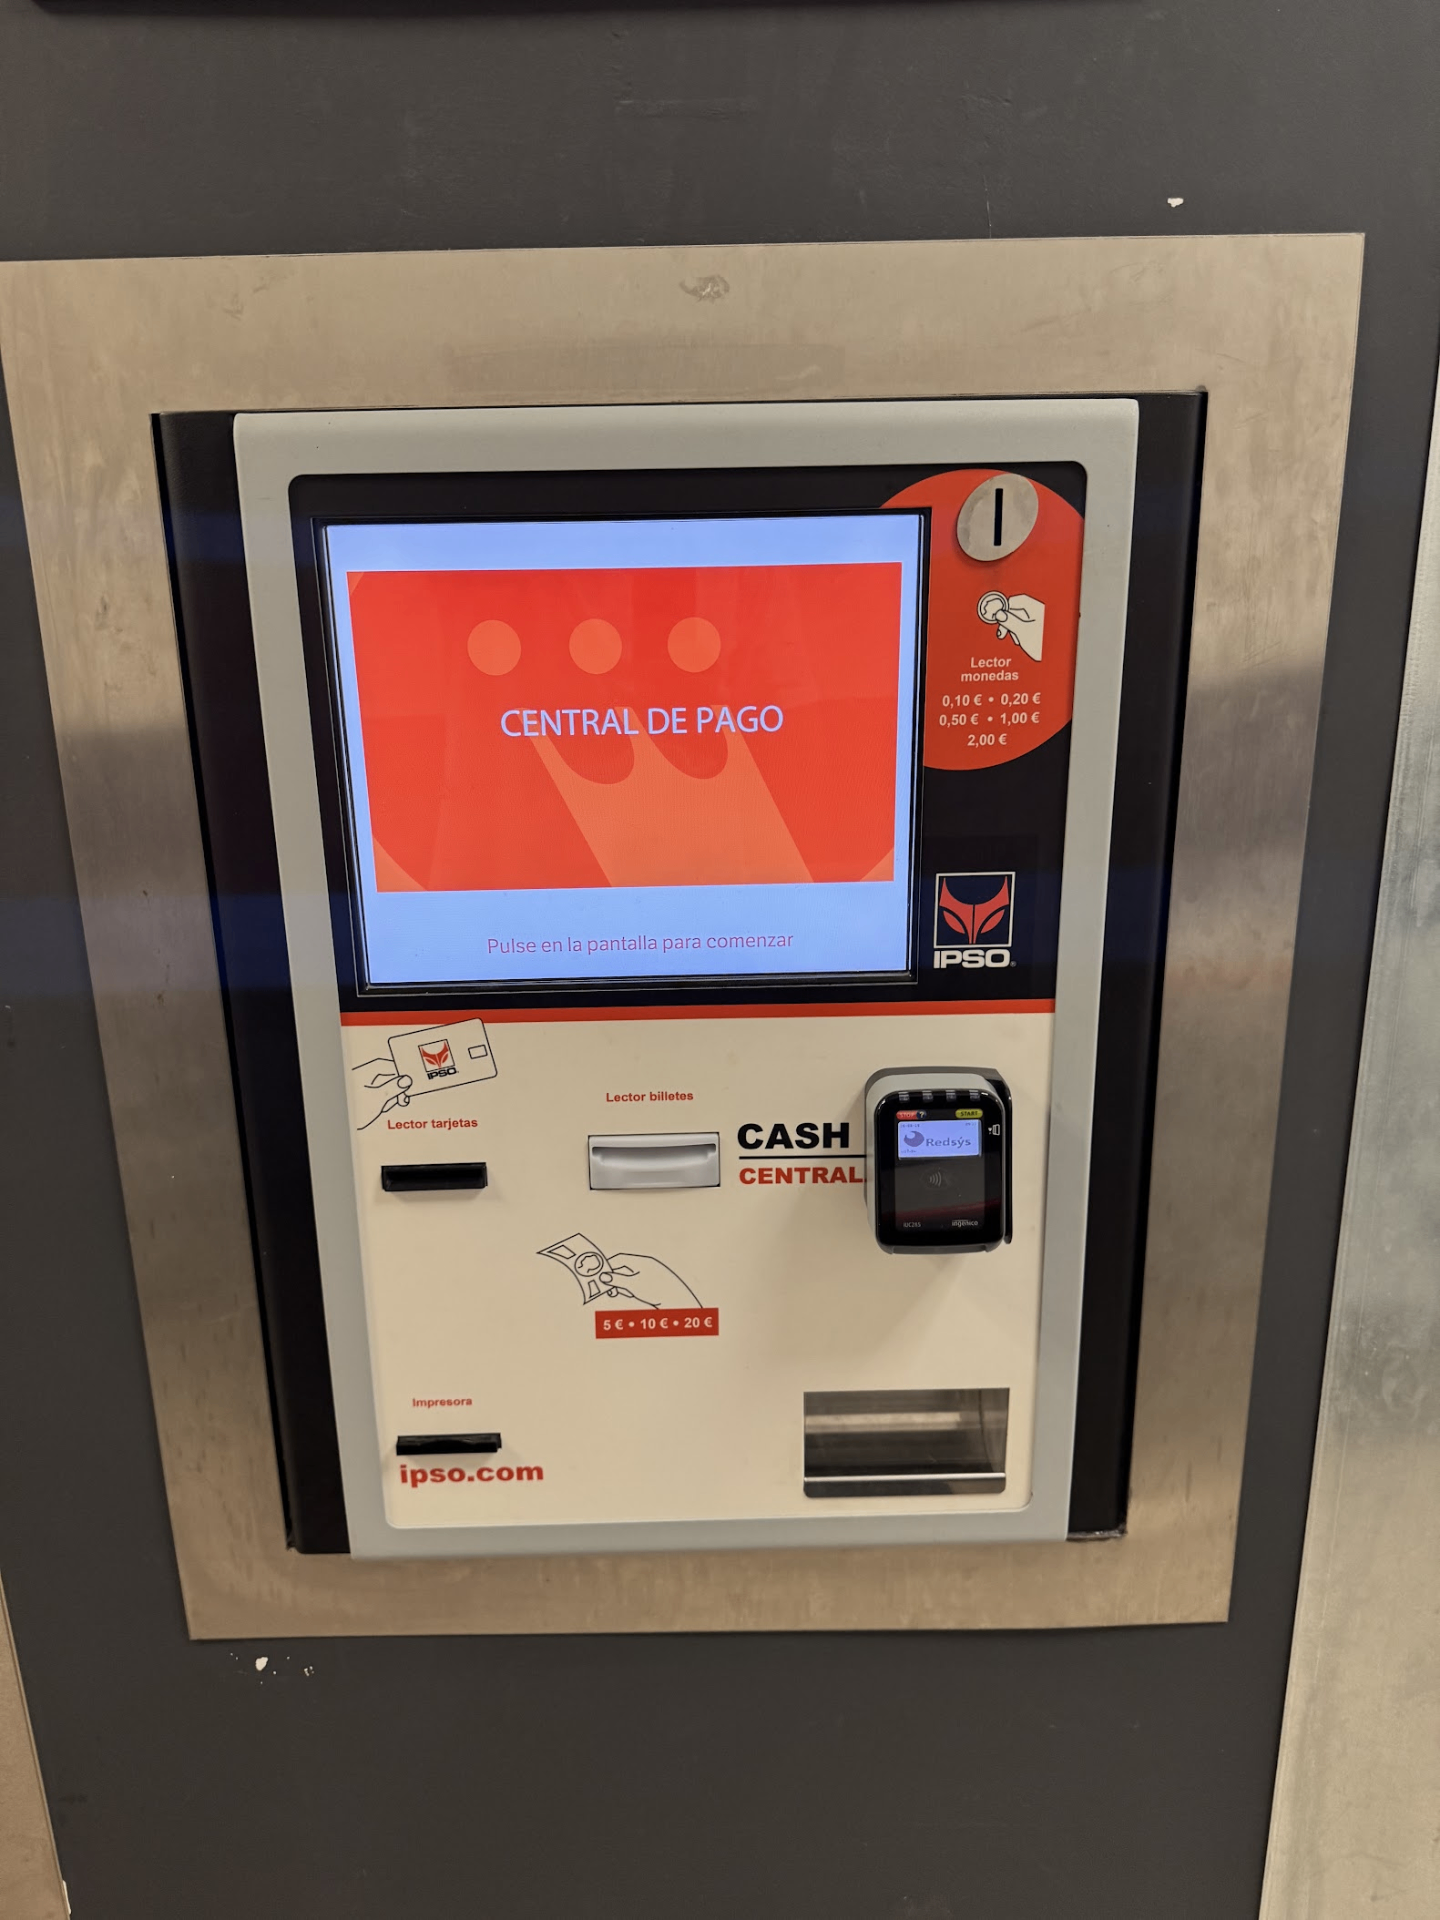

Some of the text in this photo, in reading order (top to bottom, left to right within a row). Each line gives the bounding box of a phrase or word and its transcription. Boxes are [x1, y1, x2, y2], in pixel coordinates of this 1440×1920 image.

[970, 657, 1011, 668] Lector
[960, 671, 1019, 682] monedas
[942, 694, 970, 709] 0,10
[1000, 693, 1029, 706] 0,20
[501, 705, 784, 737] CENTRAL DE PAGO
[939, 714, 967, 728] 0,50
[1000, 713, 1028, 726] 1,00
[967, 734, 997, 748] 2,00
[487, 933, 794, 955] Pulse en la pantalla para comenzar
[933, 948, 1011, 969] IPSO
[426, 1067, 458, 1080] IPSO
[605, 1091, 694, 1102] Lector billetes
[387, 1118, 478, 1130] Lector tarjetas
[737, 1122, 850, 1150] CASH
[603, 1316, 713, 1331] 5 € 10 € 20 €
[412, 1397, 473, 1409] Impresora
[400, 1464, 544, 1488] ipso.com
